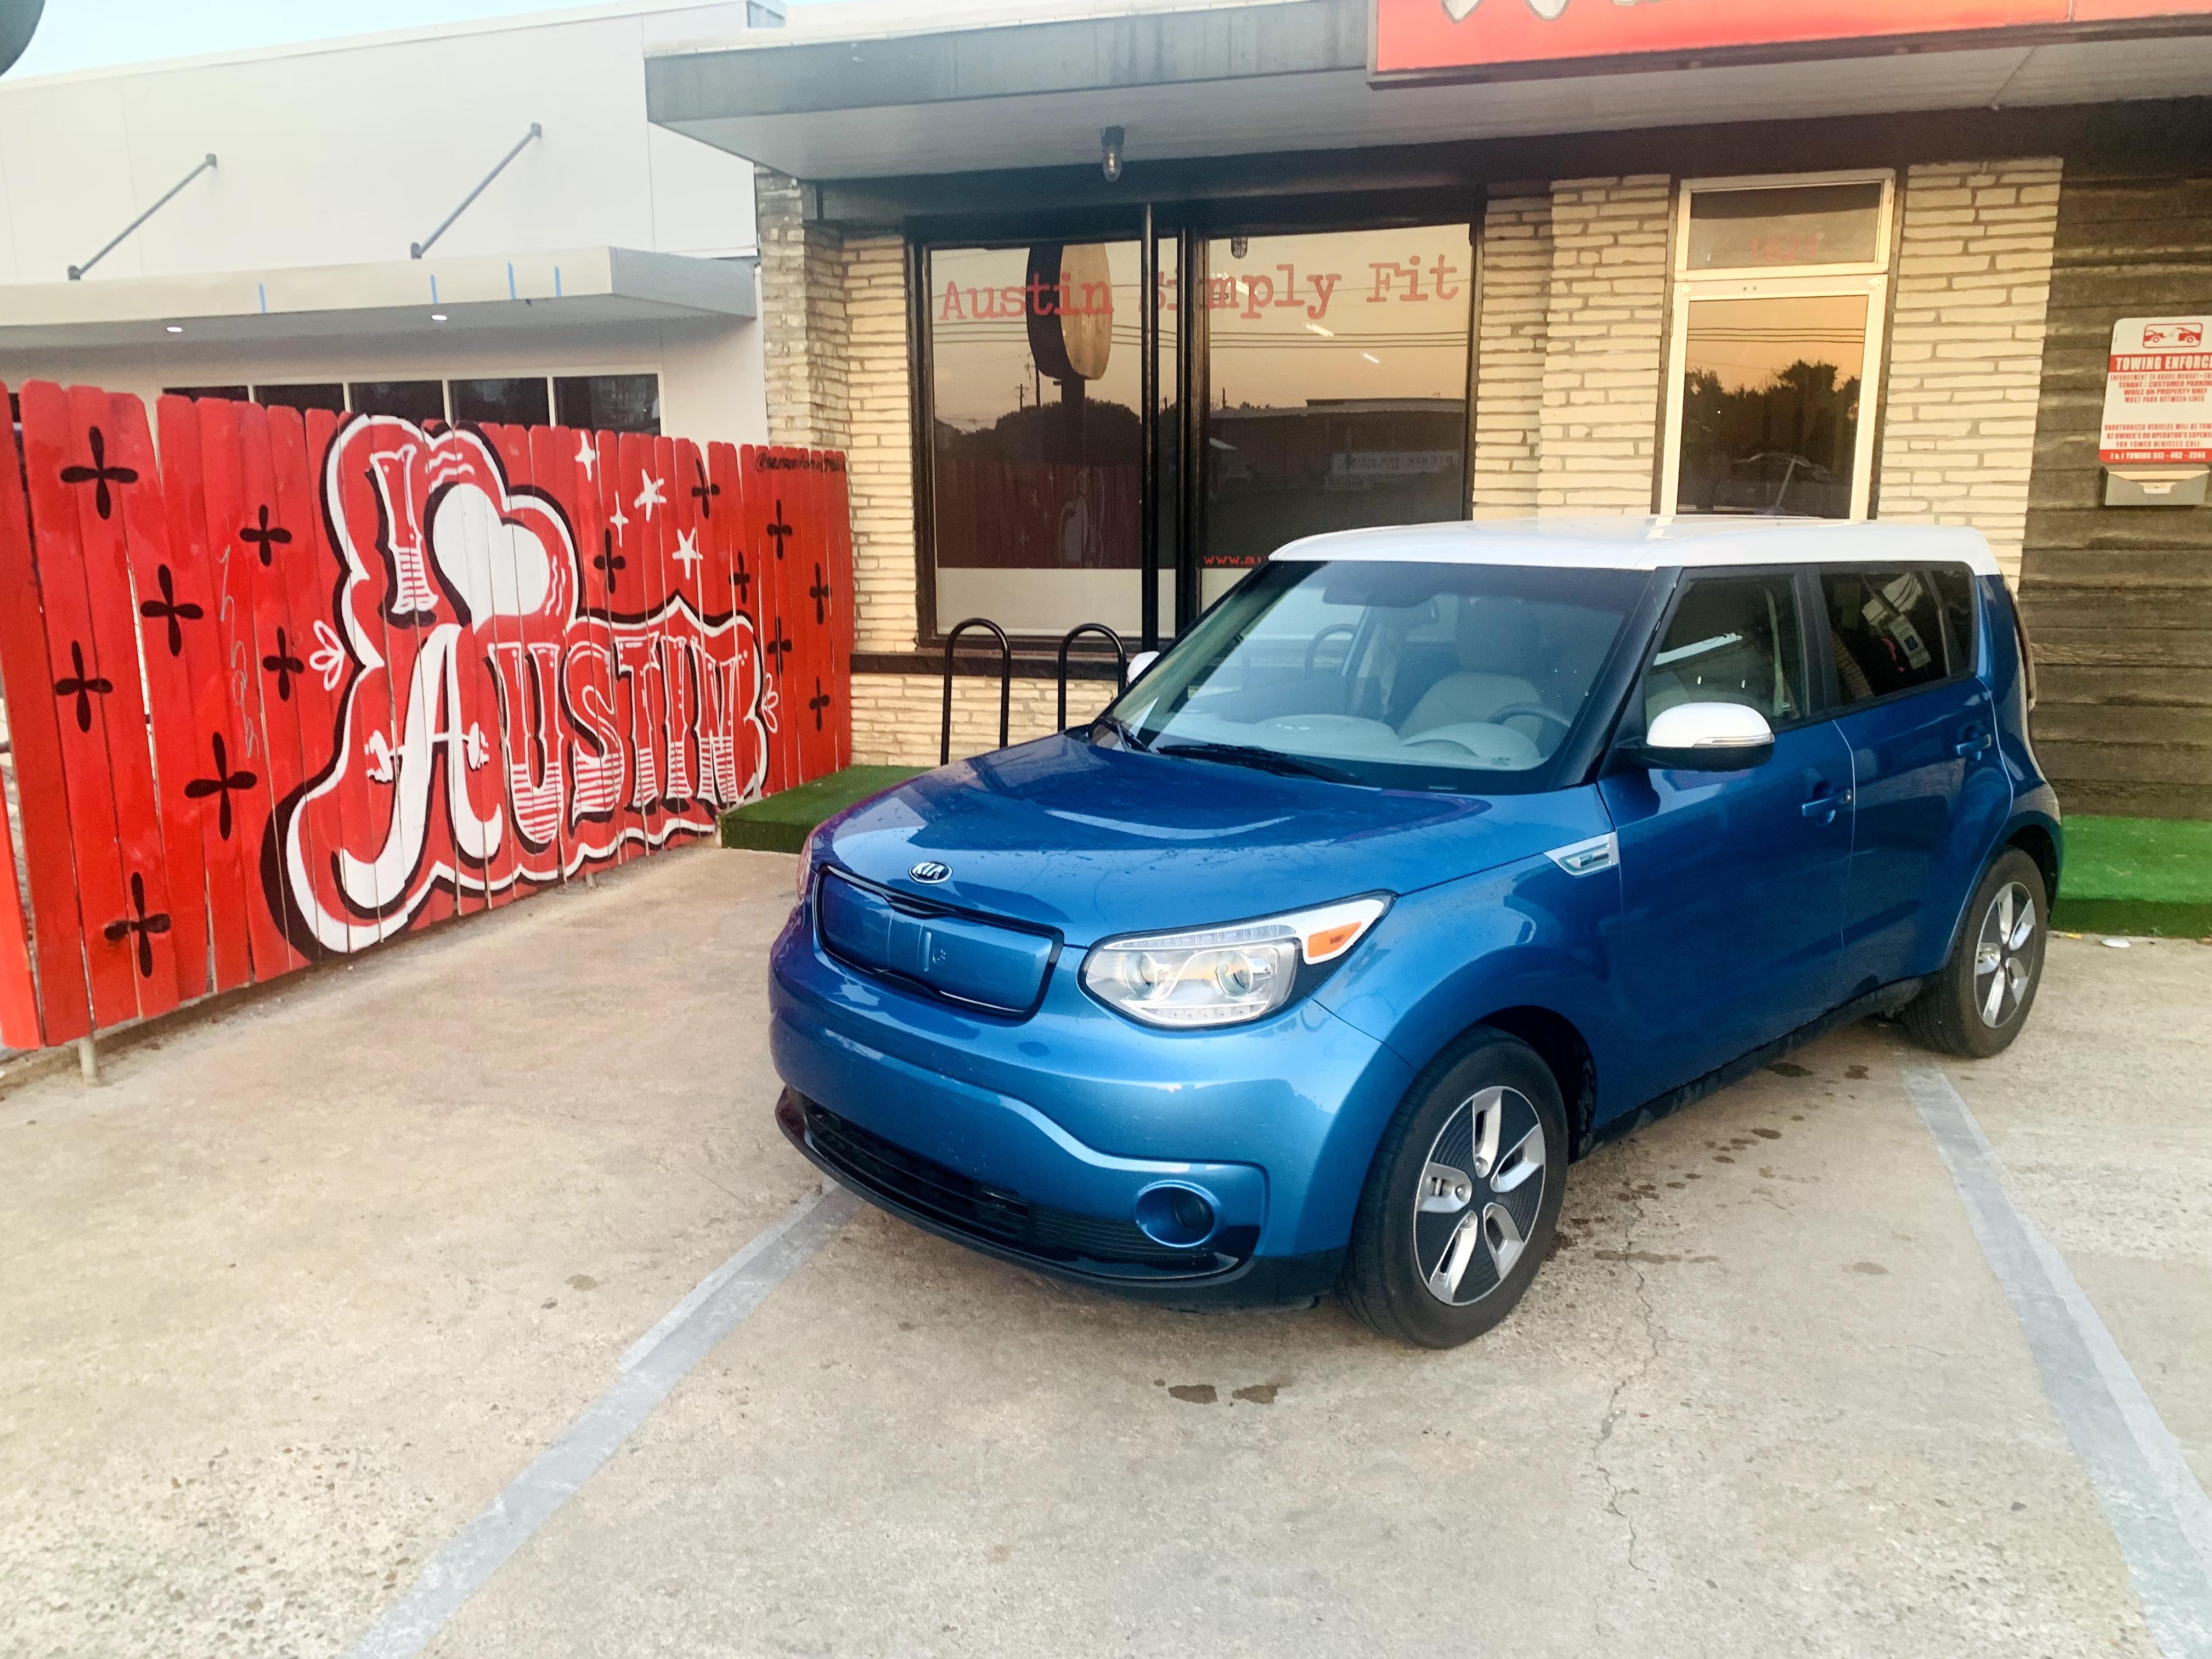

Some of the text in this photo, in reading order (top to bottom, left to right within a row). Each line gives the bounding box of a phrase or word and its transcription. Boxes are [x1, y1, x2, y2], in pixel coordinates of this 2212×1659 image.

[939, 255, 1459, 320] Austin mply Fit
[2116, 356, 2162, 370] TOWING
[911, 861, 945, 880] KIA
